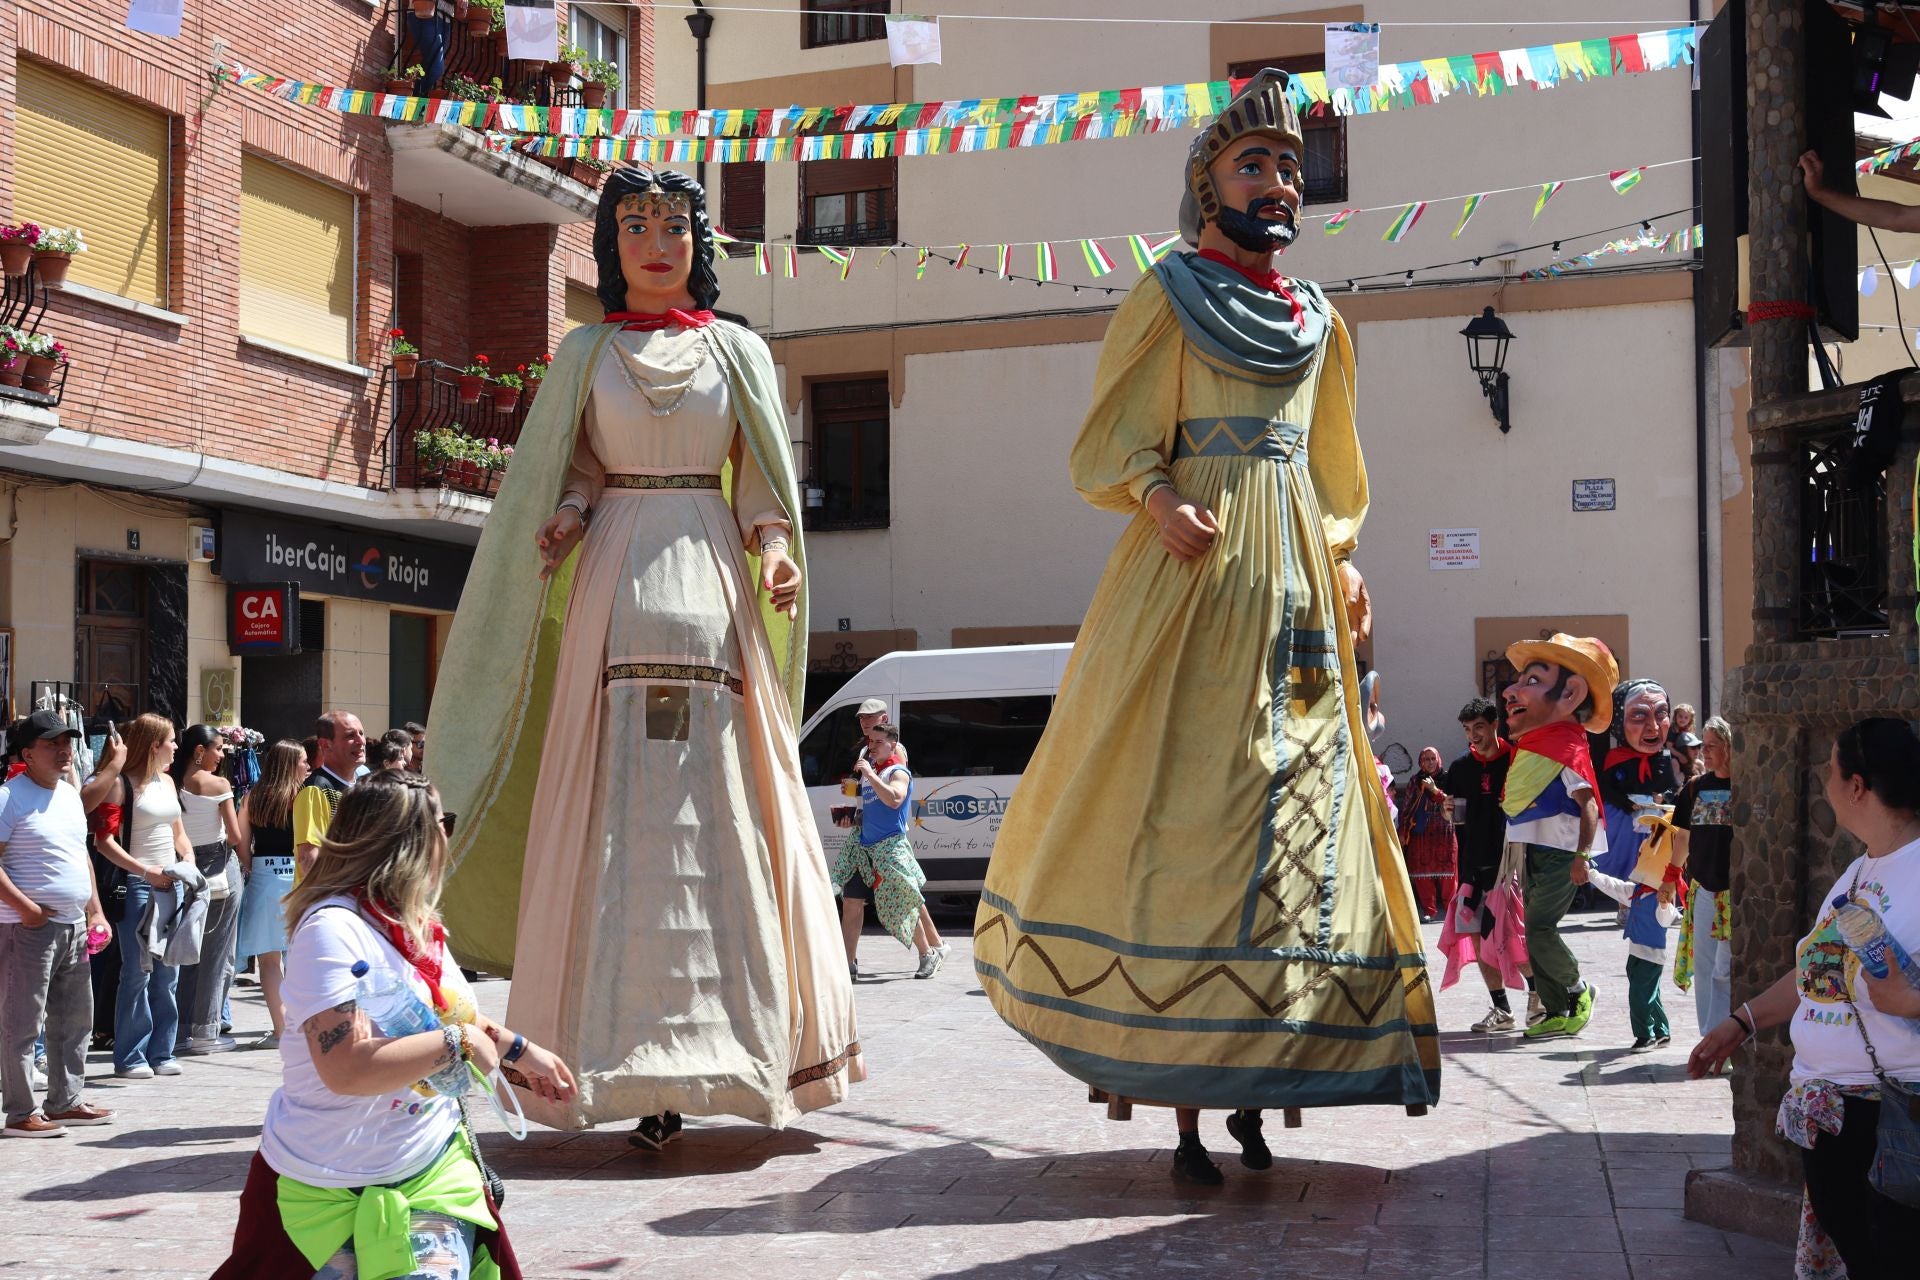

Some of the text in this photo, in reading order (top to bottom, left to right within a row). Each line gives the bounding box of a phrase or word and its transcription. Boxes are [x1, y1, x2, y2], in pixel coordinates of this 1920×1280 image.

[131, 533, 138, 548] 4
[266, 534, 429, 592] iberCaja Rioja
[242, 596, 278, 619] CA
[841, 620, 848, 630] 3
[927, 799, 1006, 815] EURO SEAT
[913, 840, 929, 850] No
[933, 838, 961, 850] limits
[966, 839, 977, 850] to
